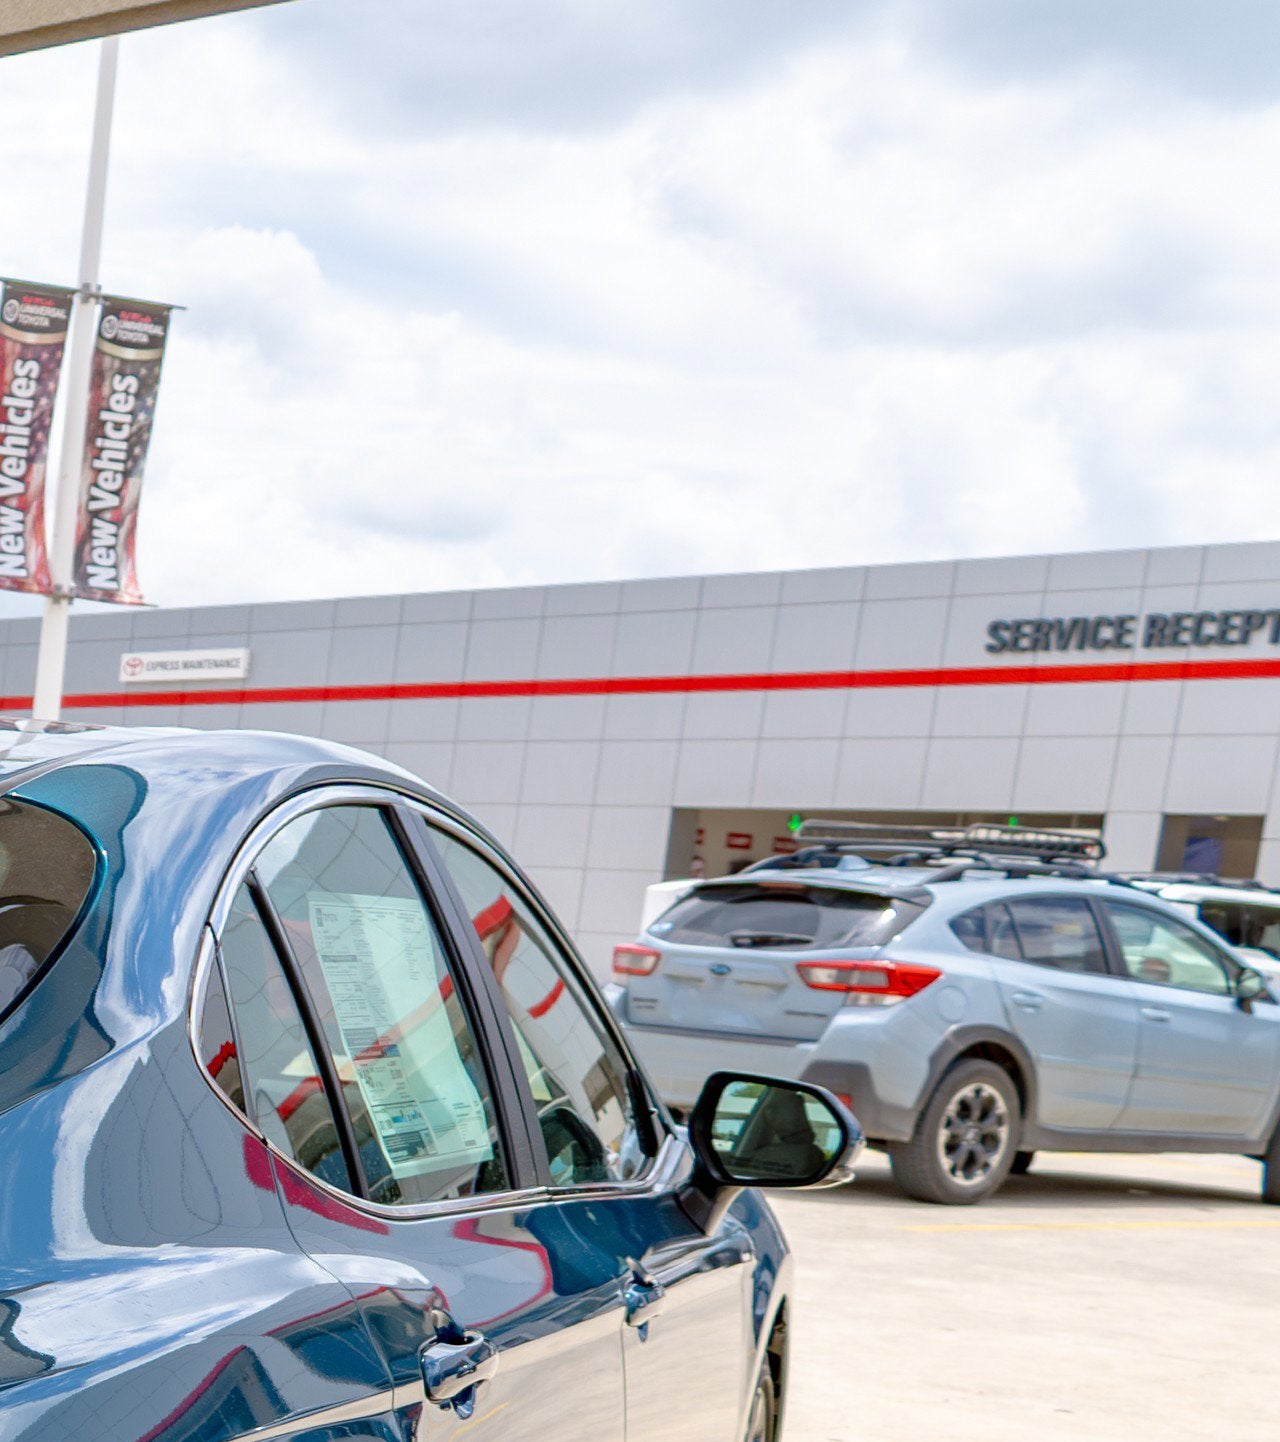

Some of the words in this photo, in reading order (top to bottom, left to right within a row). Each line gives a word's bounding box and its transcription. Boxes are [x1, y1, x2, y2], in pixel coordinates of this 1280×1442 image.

[88, 373, 139, 511] Vehicles
[87, 518, 120, 590] New
[985, 614, 1138, 653] SERVICE
[146, 660, 179, 671] EXPRESS
